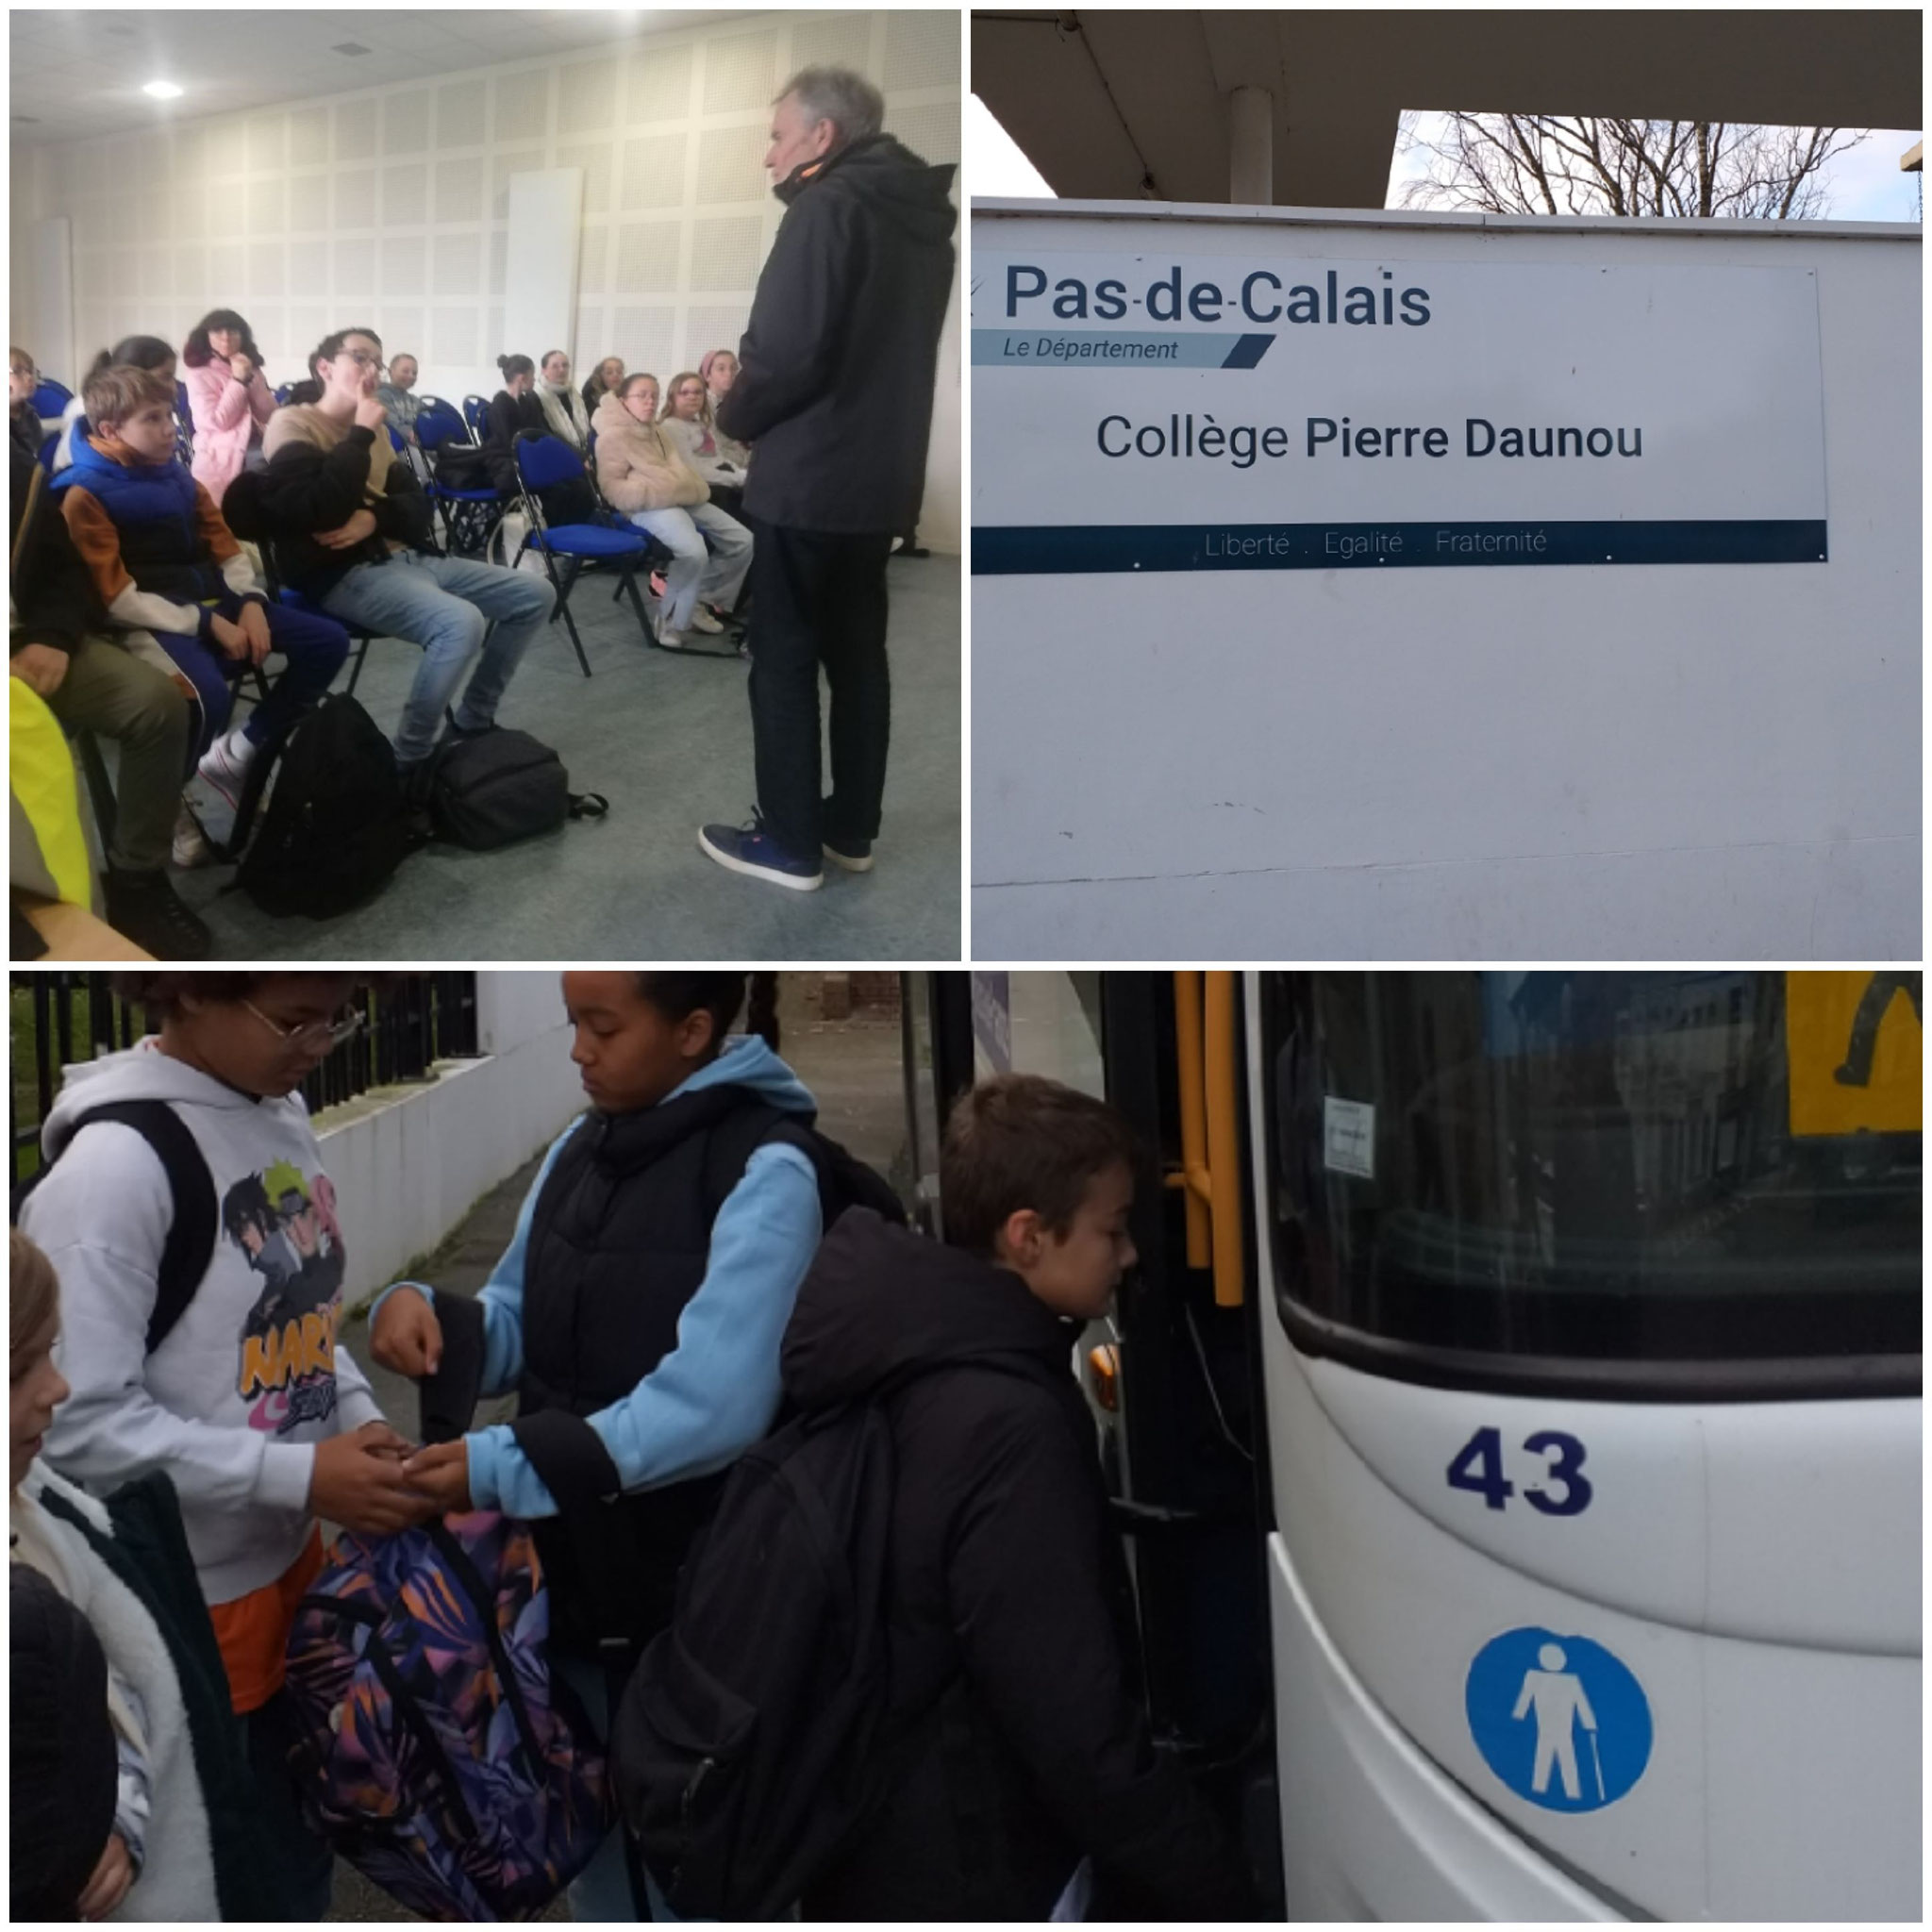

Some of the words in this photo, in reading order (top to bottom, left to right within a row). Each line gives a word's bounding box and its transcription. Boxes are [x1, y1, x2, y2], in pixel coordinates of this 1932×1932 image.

[1006, 265, 1432, 326] Pas-de-Calais
[1003, 337, 1030, 357] Le
[1036, 338, 1179, 361] Département
[1097, 413, 1289, 469] Collège
[1307, 417, 1449, 458] Pierre
[1465, 418, 1643, 458] Daunou
[1205, 532, 1291, 557] Liberté
[1324, 531, 1404, 559] Egalité
[1435, 529, 1548, 553] Fraternité
[1446, 1425, 1593, 1517] 43
